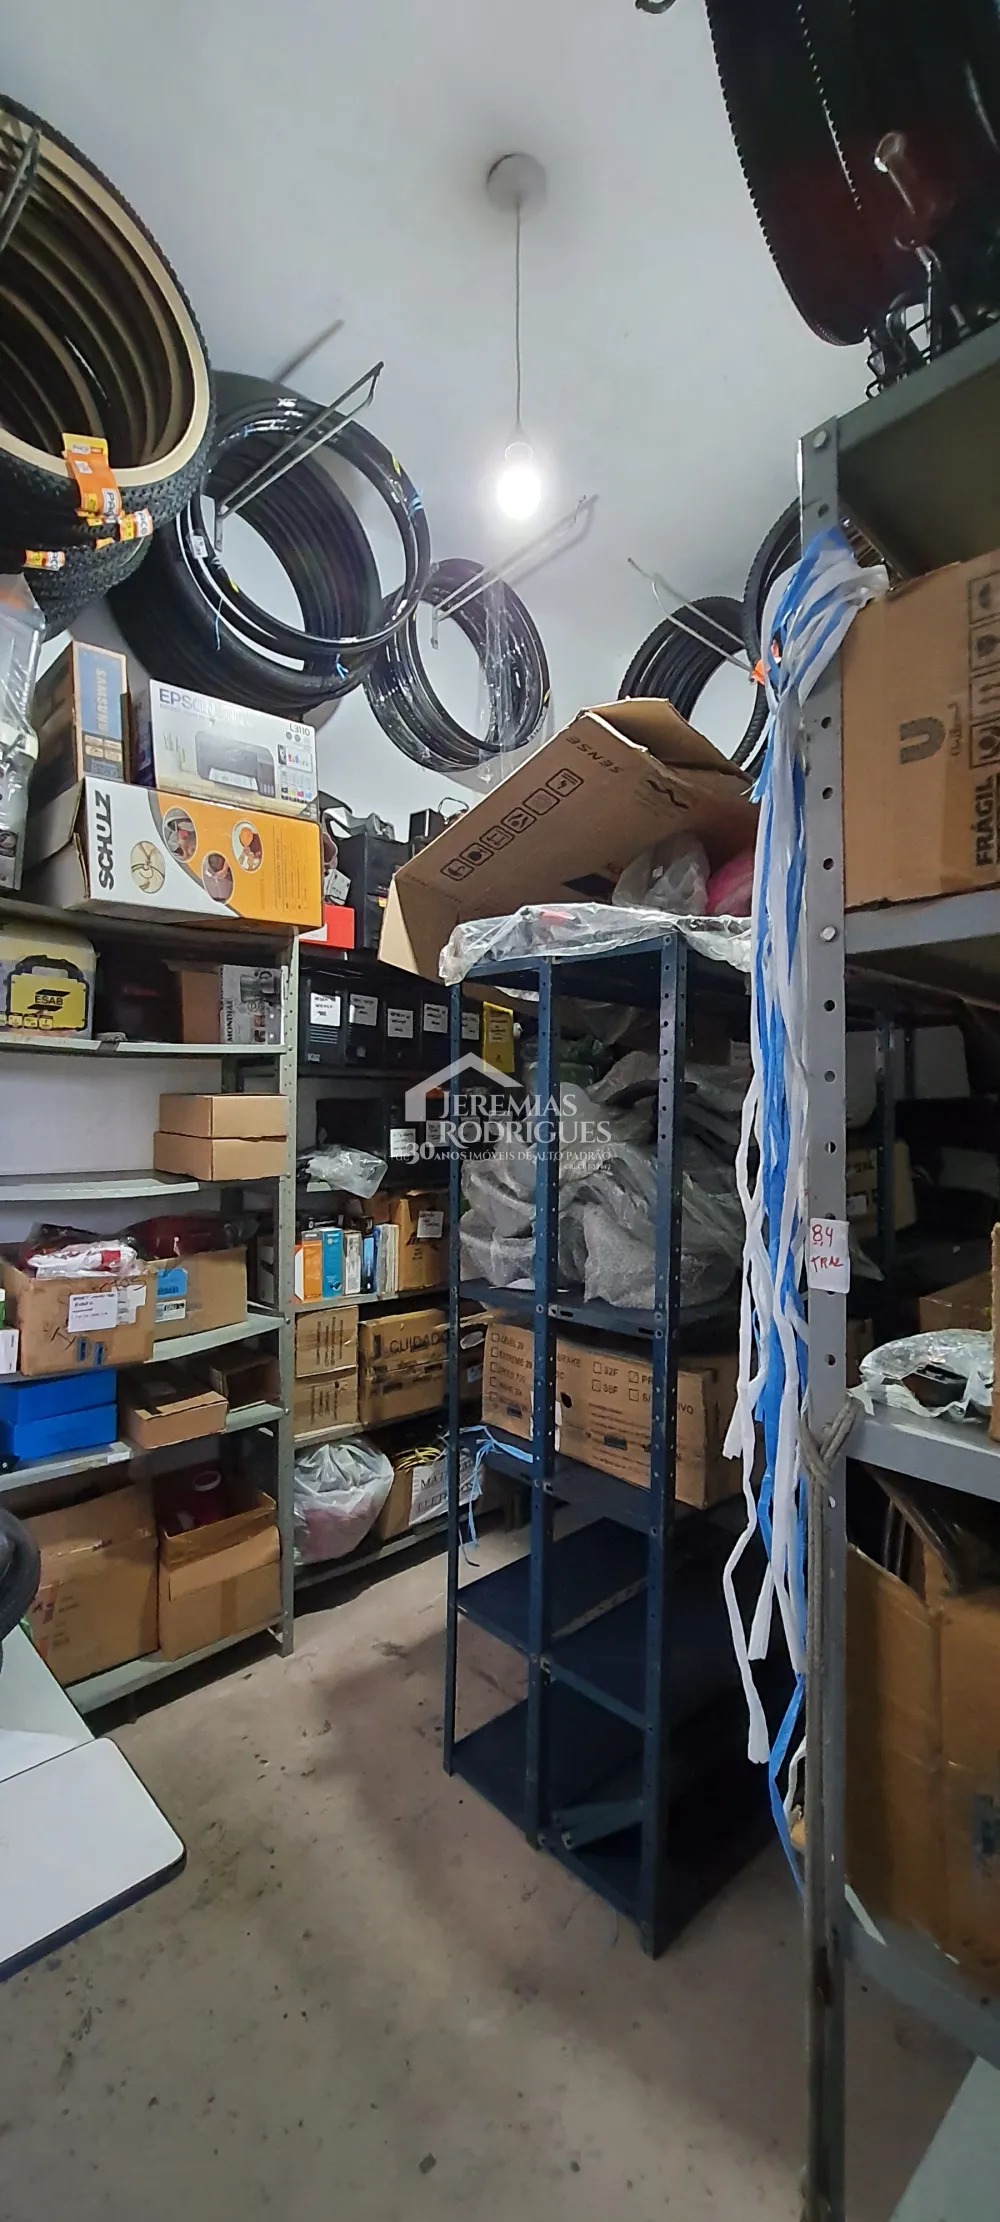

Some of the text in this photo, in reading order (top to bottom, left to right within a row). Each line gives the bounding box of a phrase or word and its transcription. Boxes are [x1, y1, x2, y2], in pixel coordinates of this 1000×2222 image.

[566, 736, 625, 774] SENSE
[94, 790, 115, 891] SCHULZ
[970, 775, 995, 868] FRÁGIL
[35, 995, 64, 1006] ESAB
